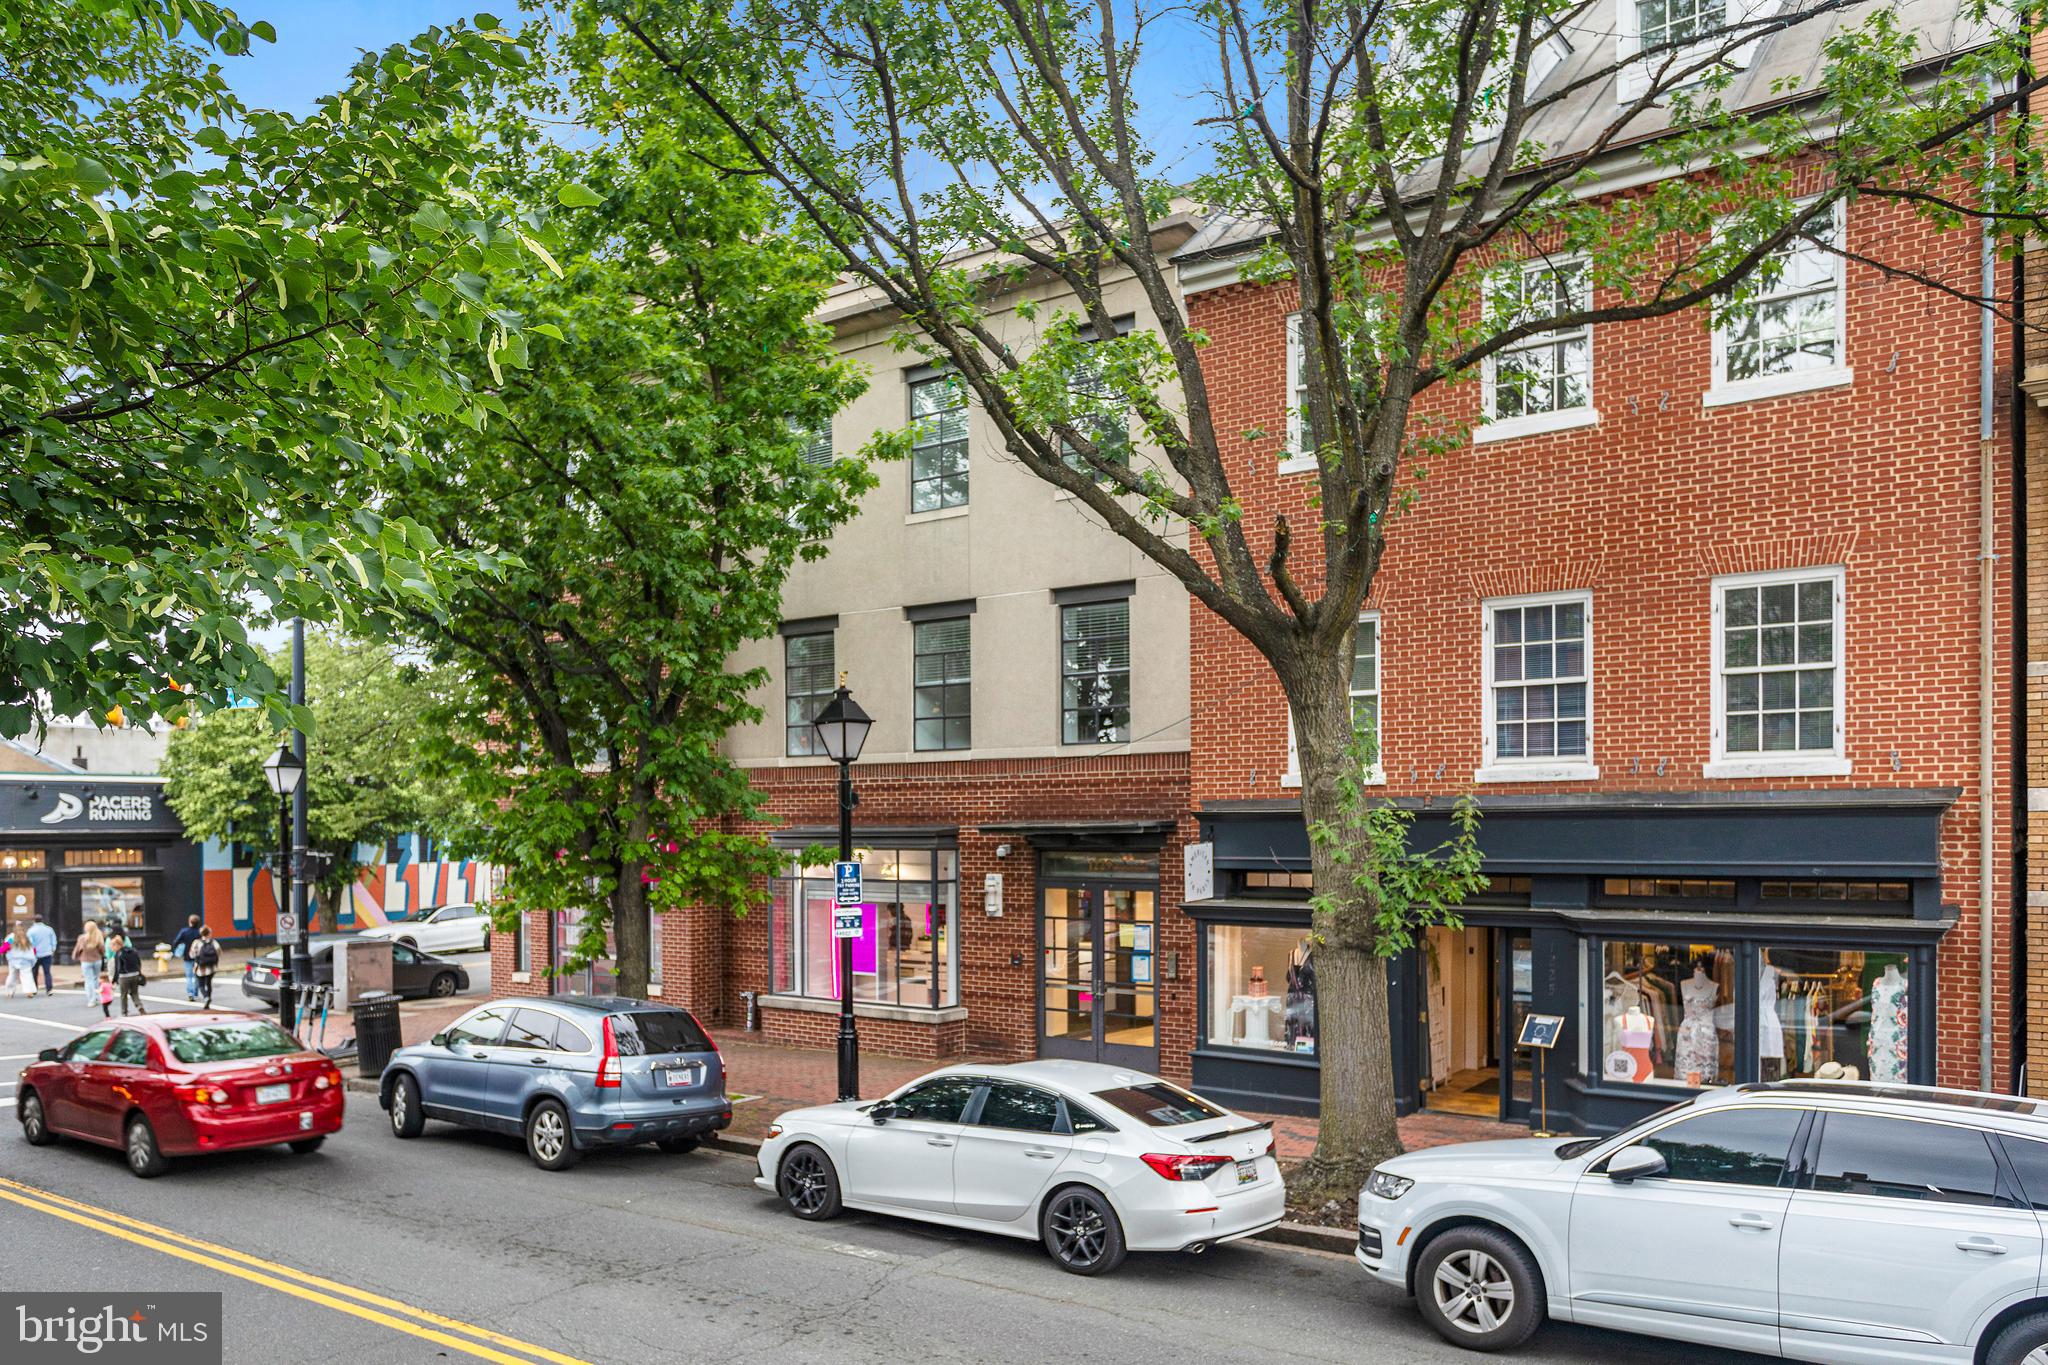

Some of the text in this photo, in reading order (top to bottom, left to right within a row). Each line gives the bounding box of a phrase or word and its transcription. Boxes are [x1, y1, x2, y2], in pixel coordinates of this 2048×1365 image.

[89, 795, 152, 809] PACERS
[89, 809, 153, 821] RUNNING
[844, 865, 853, 877] P
